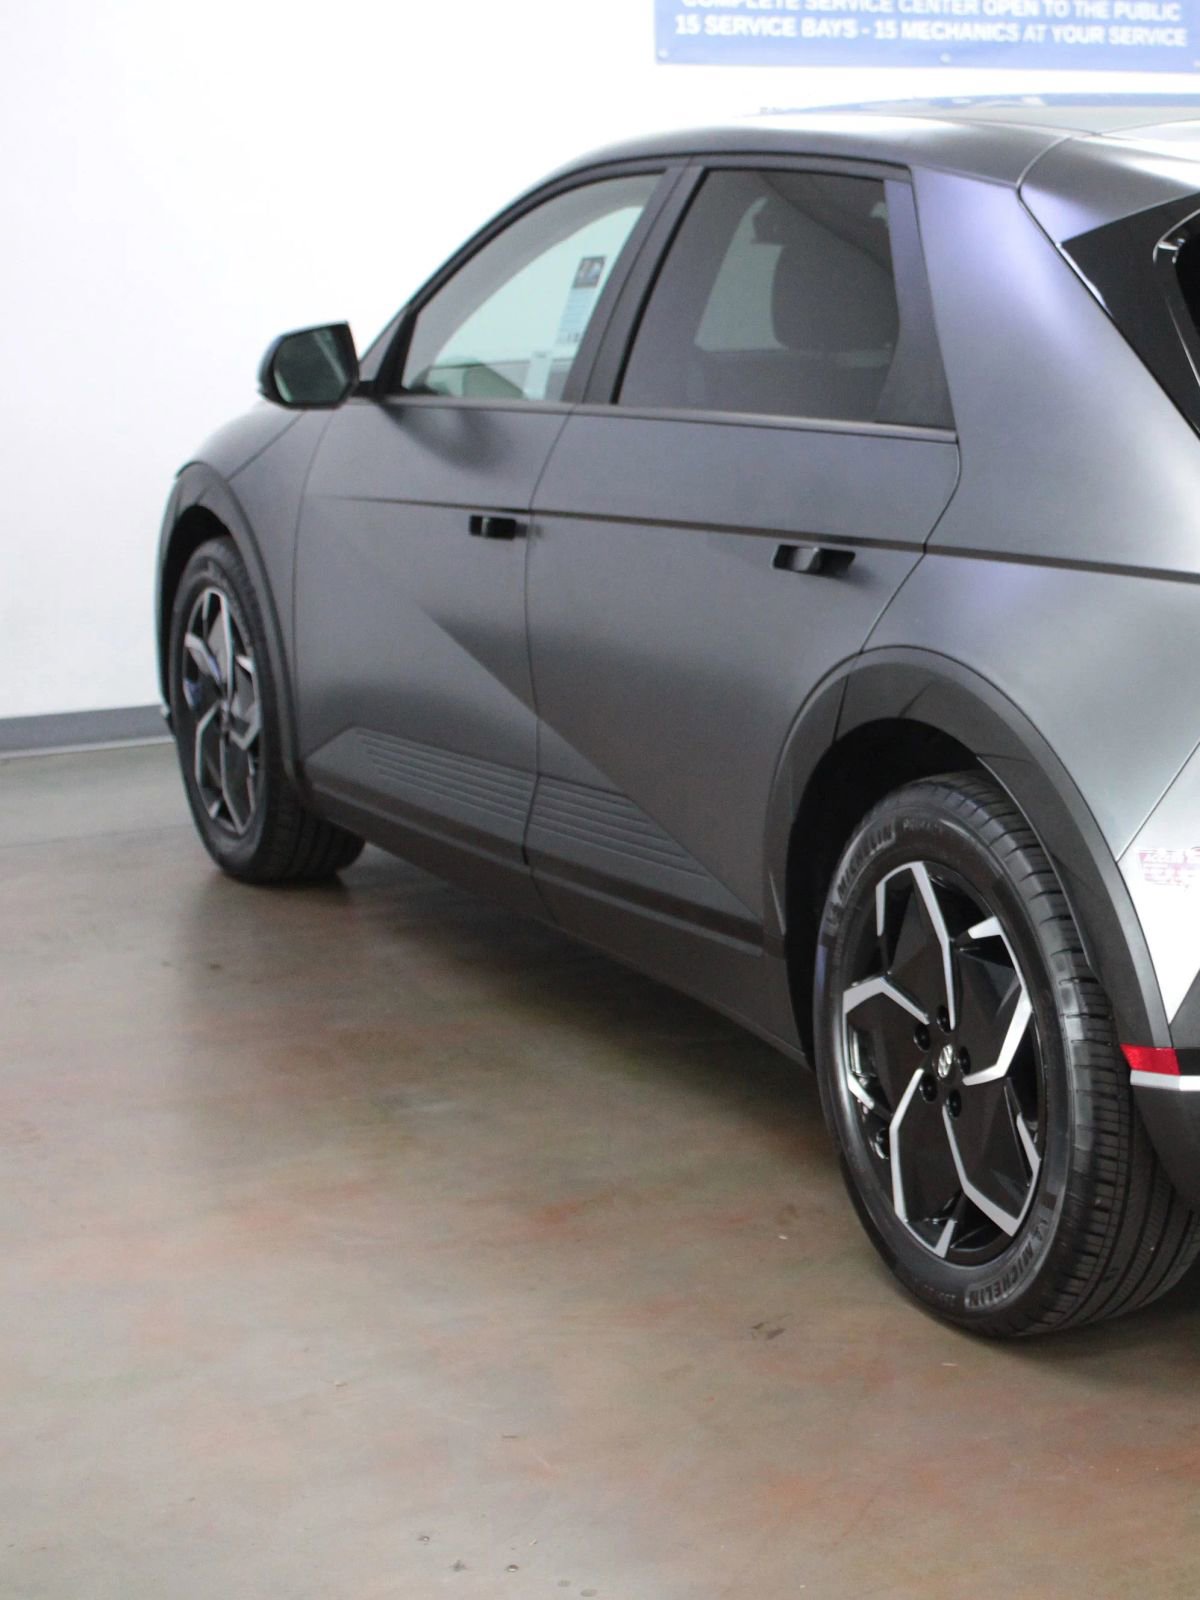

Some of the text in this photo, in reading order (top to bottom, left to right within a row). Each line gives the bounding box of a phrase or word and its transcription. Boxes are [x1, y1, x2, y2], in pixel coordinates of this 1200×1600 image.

[674, 13, 700, 35] 15
[703, 14, 798, 37] SERVICE
[801, 16, 858, 39] BAYS
[874, 18, 898, 39] 15
[901, 20, 1020, 42] MECHANICS
[1022, 23, 1047, 43] AT
[1050, 24, 1105, 44] YOUR
[1108, 25, 1188, 47] SERVICE
[804, 0, 893, 12] SERVICE
[898, 0, 979, 15] CENTER
[983, 0, 1040, 17] OPEN
[1045, 0, 1071, 18] TO
[1074, 0, 1110, 19] THE
[1113, 1, 1182, 21] PUBLIC
[837, 823, 896, 899] MICHELIN
[968, 1241, 1033, 1307] MICHELIN
